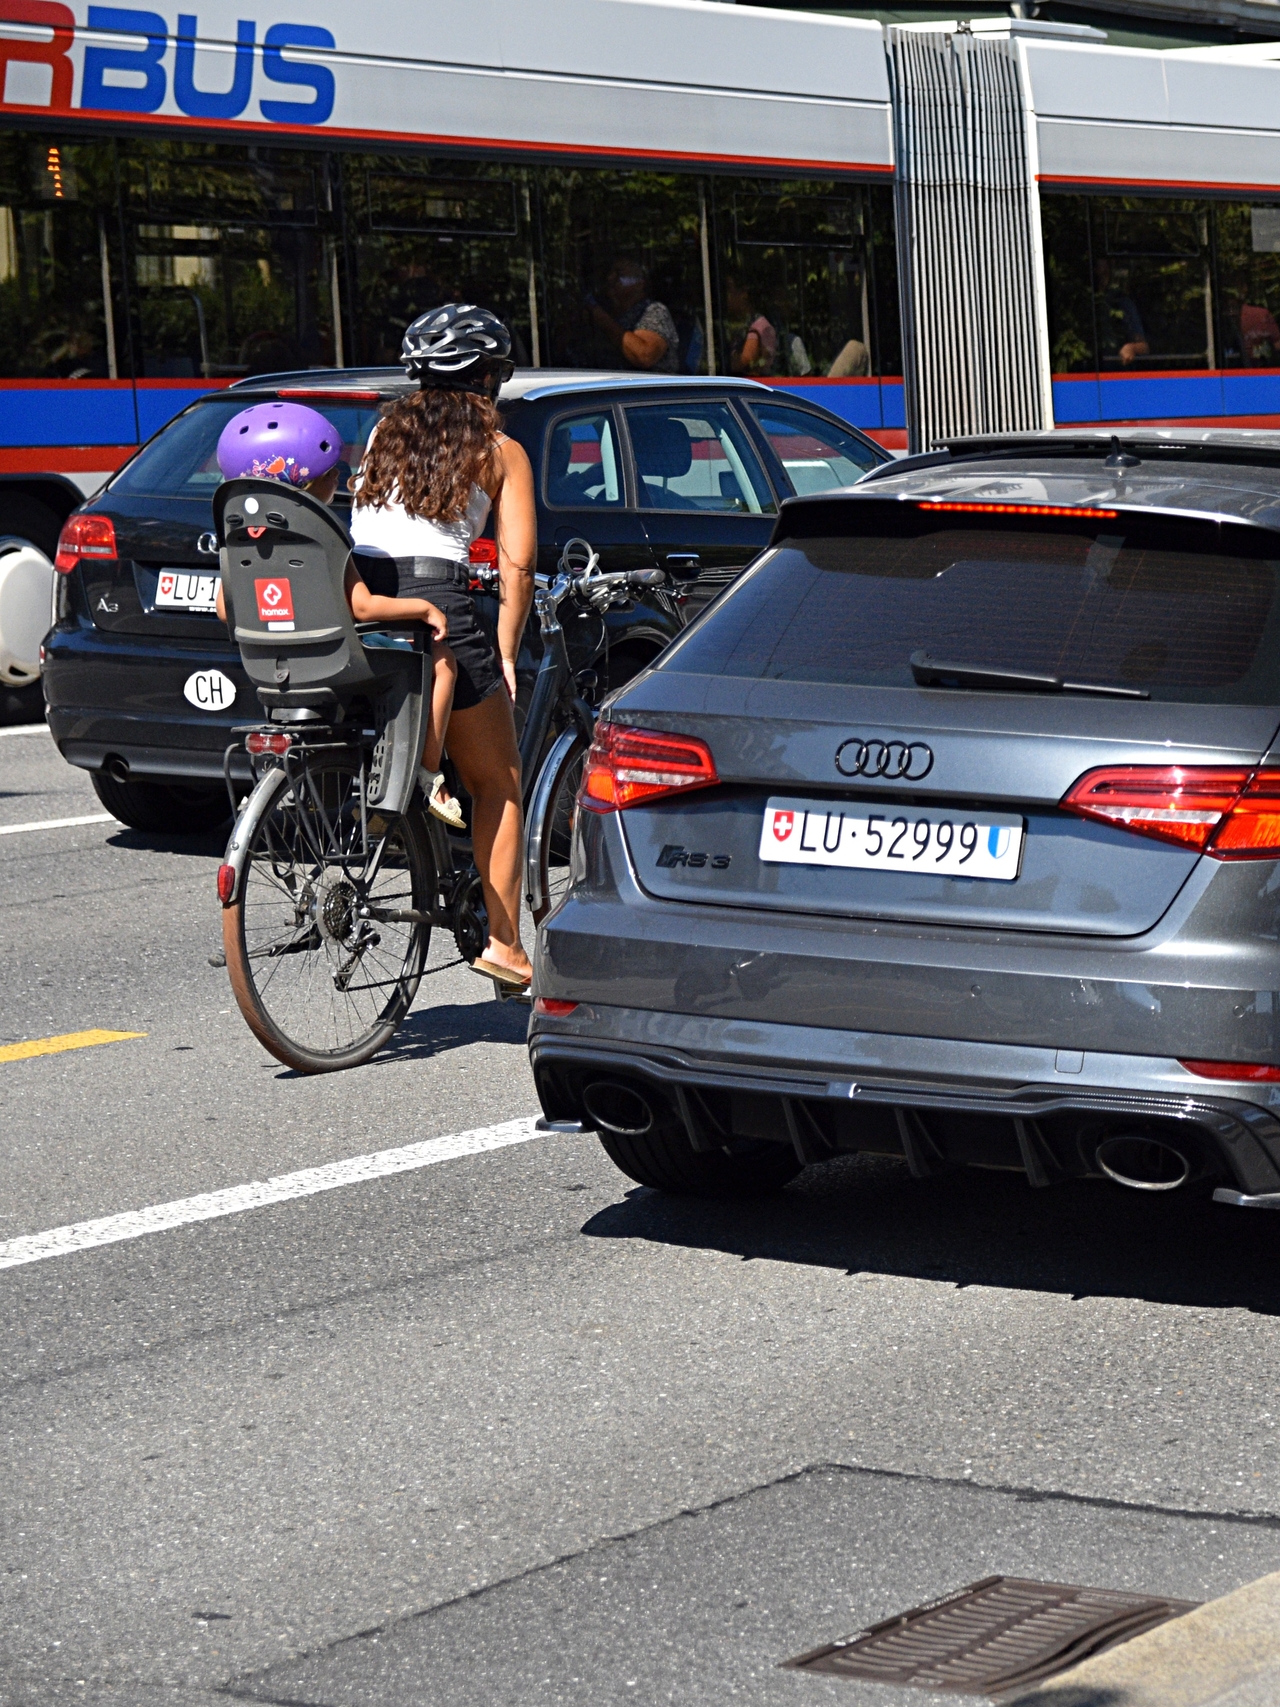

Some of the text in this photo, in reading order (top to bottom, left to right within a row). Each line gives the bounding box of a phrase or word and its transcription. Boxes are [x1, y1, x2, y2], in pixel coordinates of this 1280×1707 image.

[96, 598, 118, 612] A3
[261, 608, 289, 616] hamax
[195, 675, 223, 704] CH
[711, 855, 732, 869] 3
